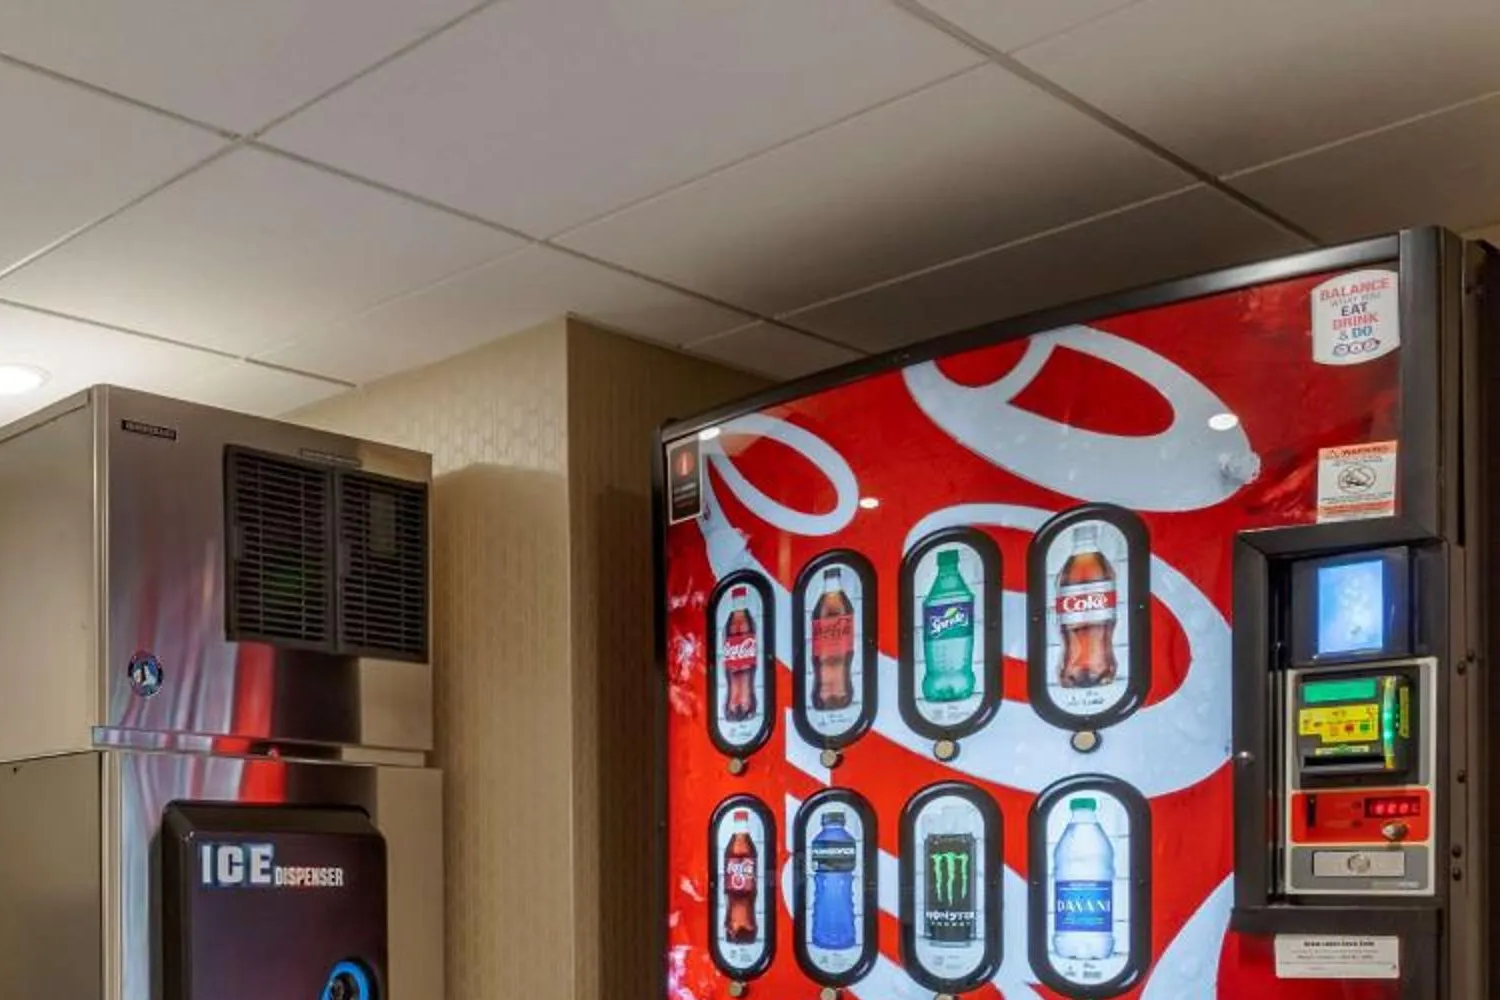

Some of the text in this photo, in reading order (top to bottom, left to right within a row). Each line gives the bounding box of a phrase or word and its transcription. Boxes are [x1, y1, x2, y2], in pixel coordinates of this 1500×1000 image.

[1320, 277, 1391, 300] BALANCE
[1341, 302, 1368, 316] EAT
[1333, 312, 1380, 330] DRINK
[1352, 326, 1372, 338] DO
[1062, 593, 1109, 612] Coke
[201, 844, 345, 887] ICE DISPENSER
